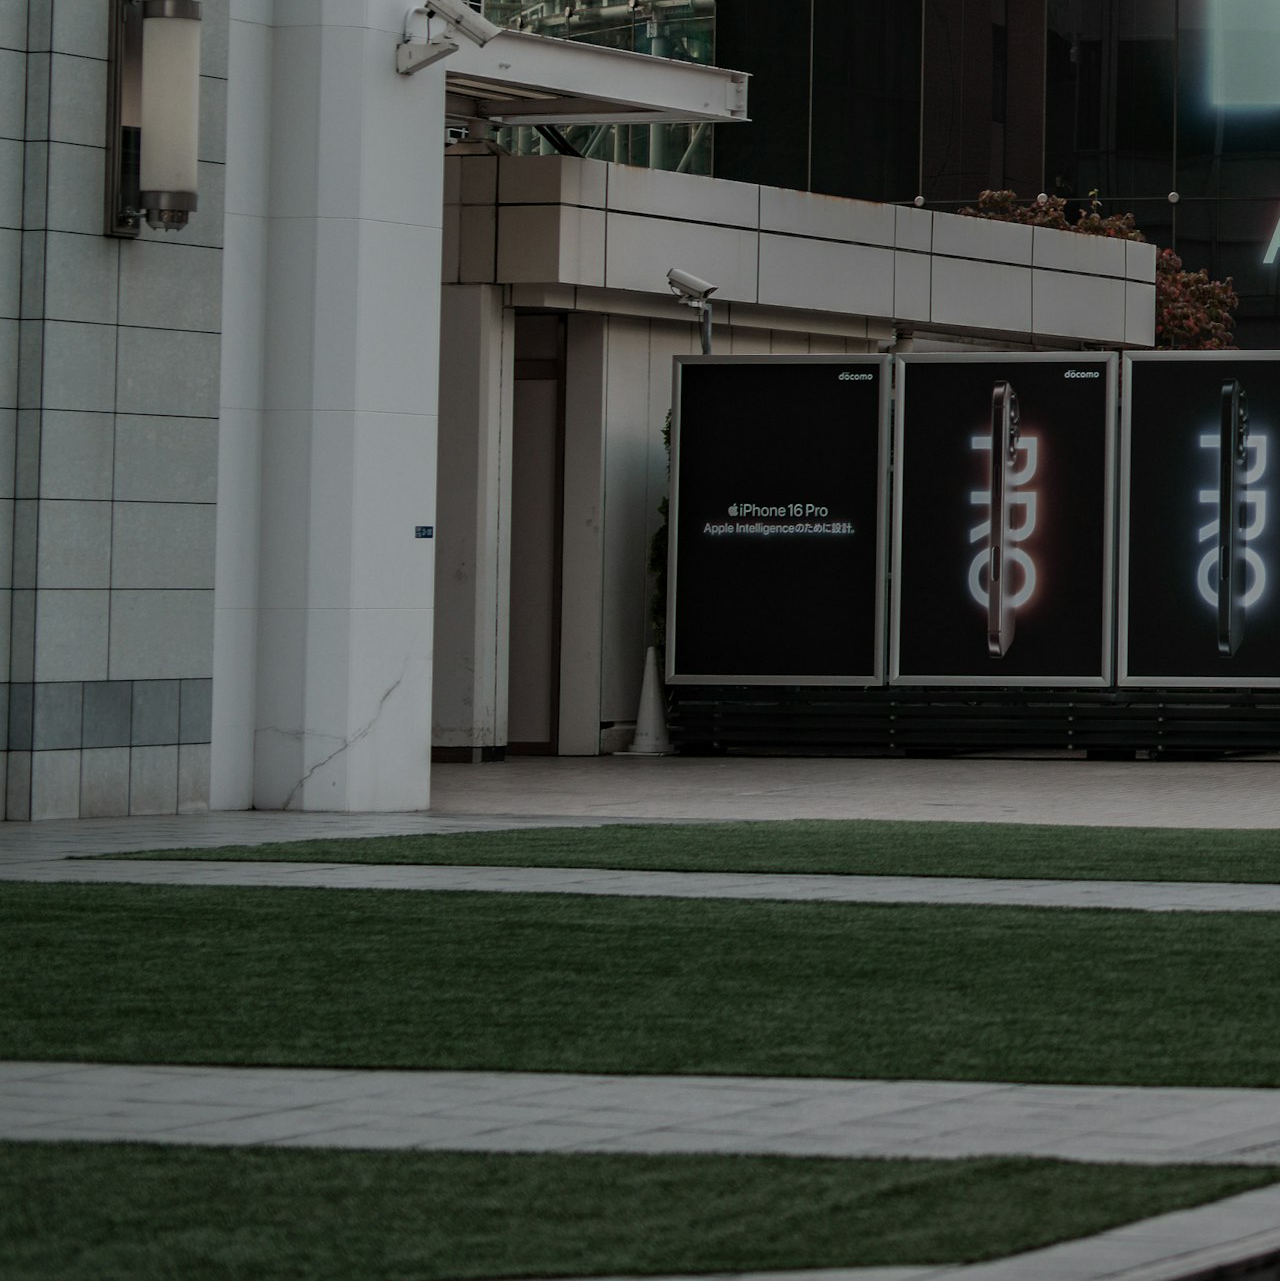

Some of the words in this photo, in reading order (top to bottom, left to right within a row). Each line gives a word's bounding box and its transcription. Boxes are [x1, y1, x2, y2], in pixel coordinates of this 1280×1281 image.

[703, 522, 734, 535] Apple
[739, 503, 786, 517] iPhone
[788, 503, 804, 517] 16
[805, 503, 829, 517] Pro
[968, 436, 1038, 611] PRO
[1196, 434, 1268, 610] PRO
